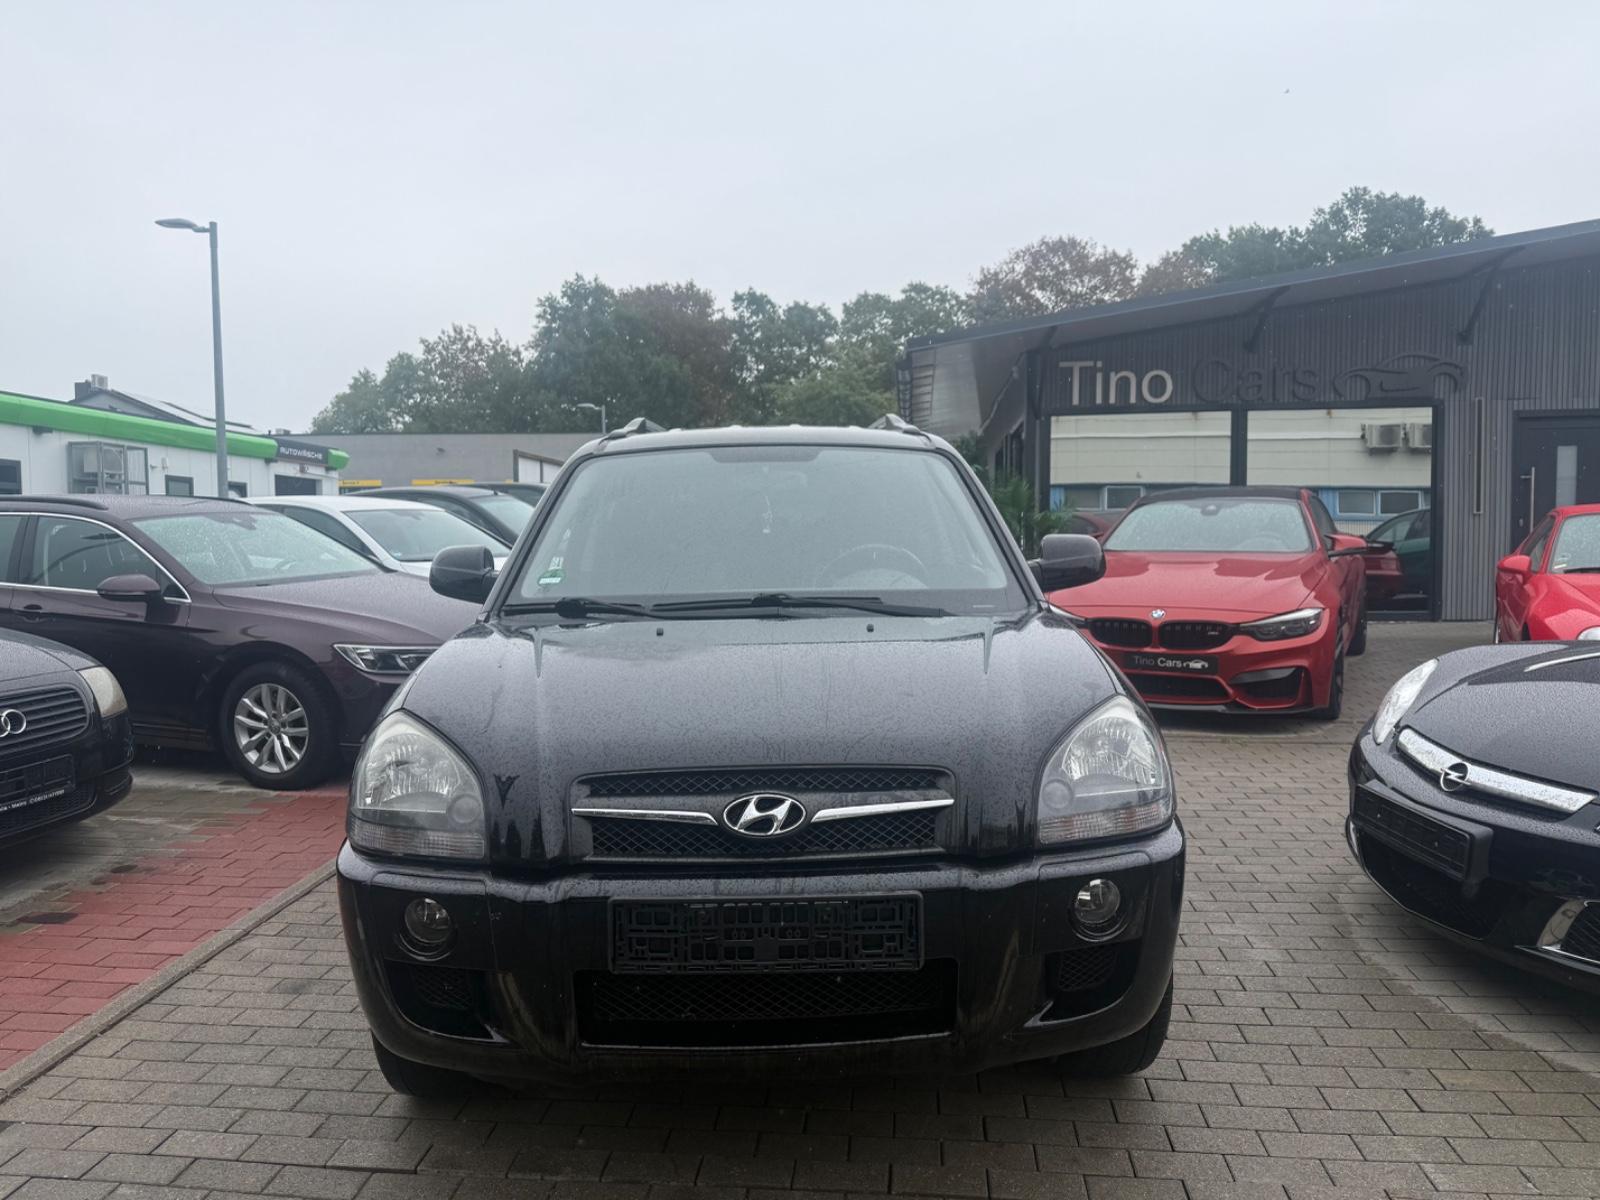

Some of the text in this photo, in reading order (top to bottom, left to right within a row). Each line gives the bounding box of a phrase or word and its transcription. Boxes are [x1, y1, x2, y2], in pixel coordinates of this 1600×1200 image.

[1059, 359, 1318, 406] Tino Cars
[1134, 655, 1182, 668] Tino Cars
